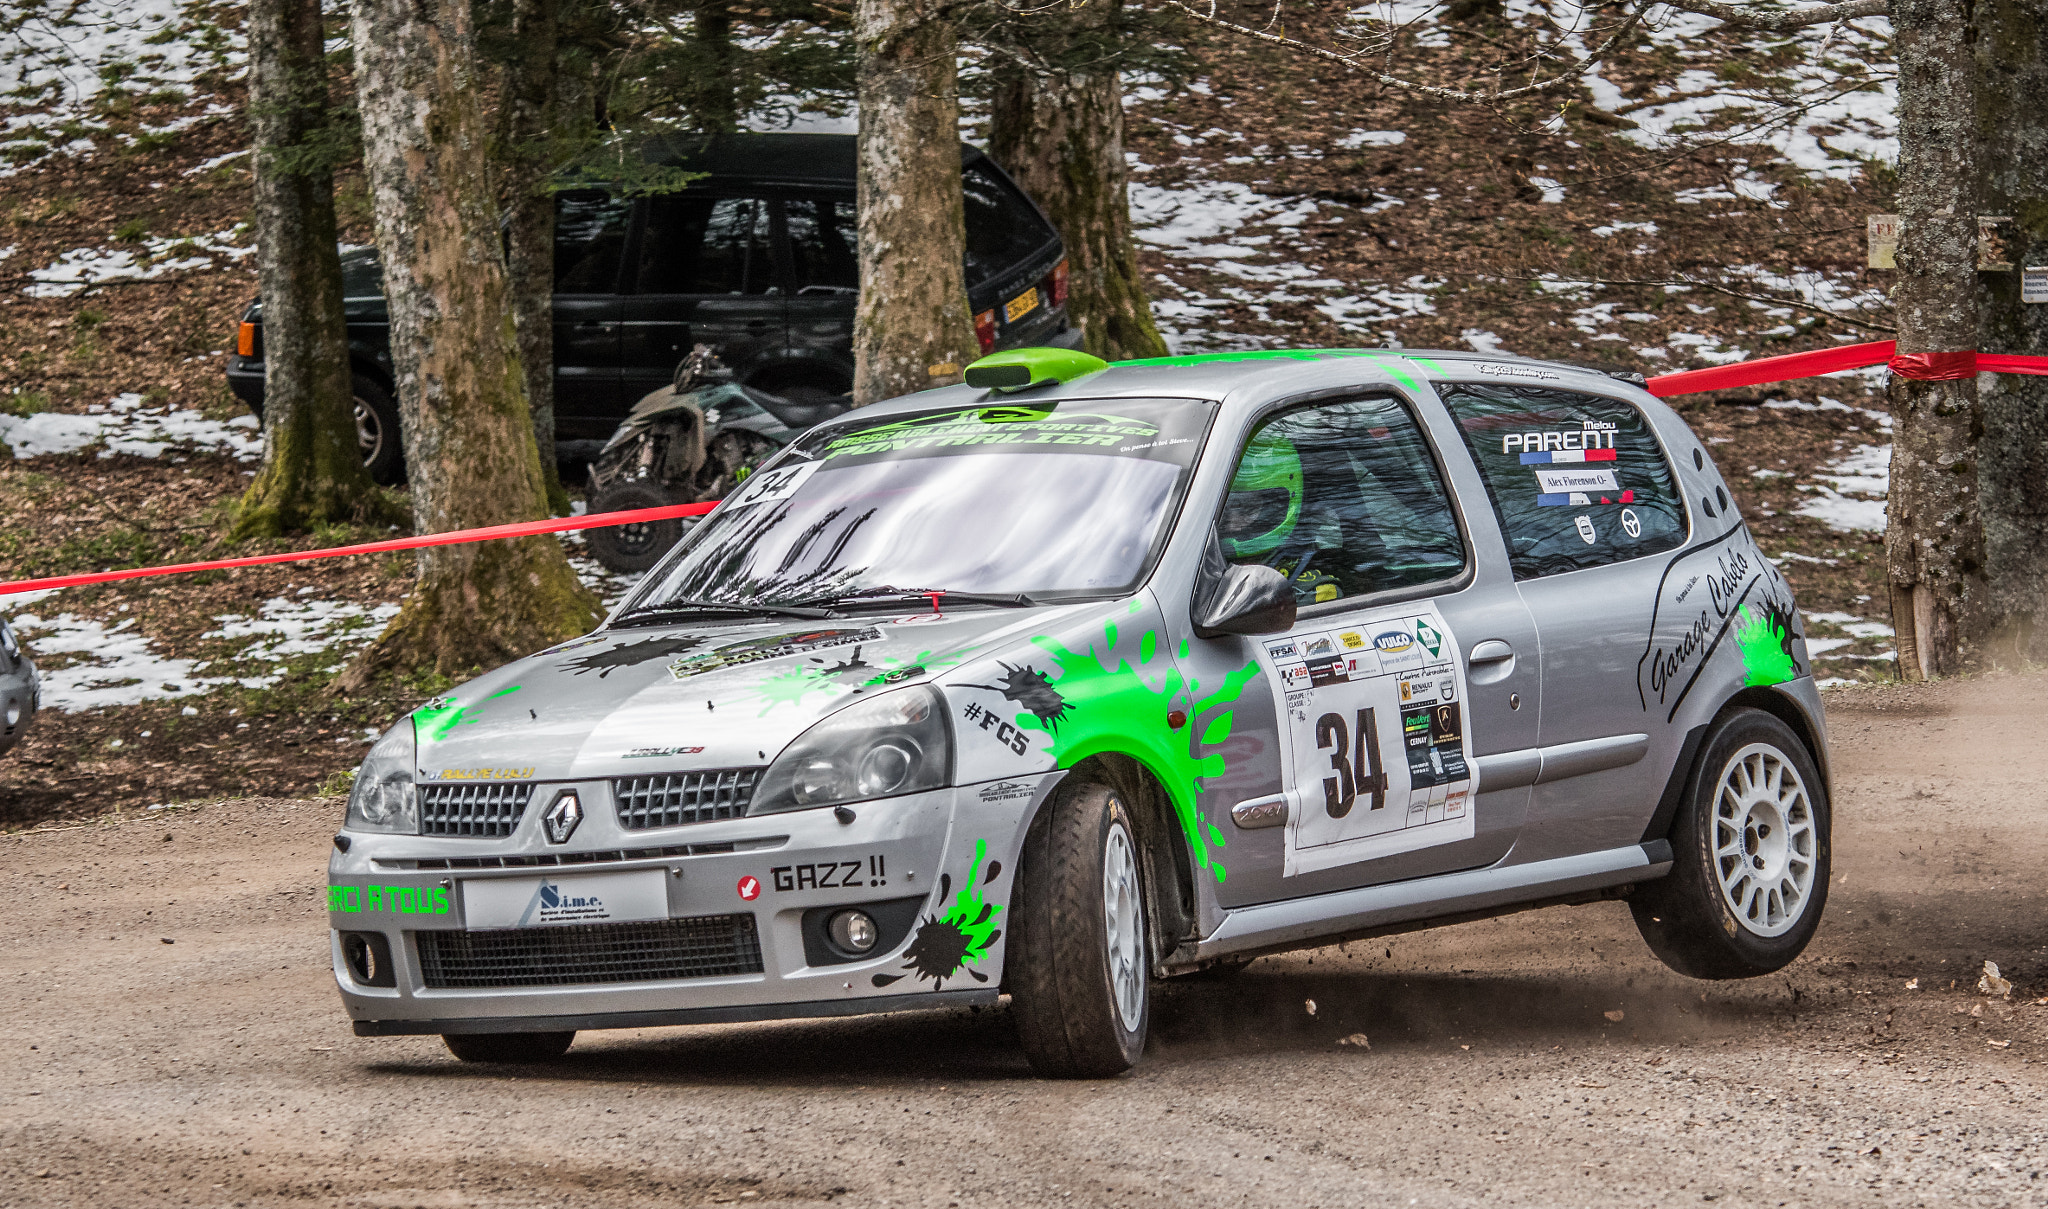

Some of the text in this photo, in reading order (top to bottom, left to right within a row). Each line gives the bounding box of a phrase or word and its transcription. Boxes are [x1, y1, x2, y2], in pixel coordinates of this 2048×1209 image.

[1583, 420, 1616, 430] Melou
[825, 432, 1124, 460] PONTARLIER
[1503, 429, 1619, 454] PARENT
[744, 465, 805, 503] 34
[1547, 476, 1563, 487] Alex
[1270, 646, 1294, 658] FFSA
[1376, 633, 1410, 650] VULCO
[1651, 609, 1711, 705] Garage
[1294, 666, 1308, 677] asa
[1315, 706, 1389, 819] 34
[441, 768, 494, 780] RALLYE
[367, 885, 383, 912] A
[384, 886, 450, 915] TOUS
